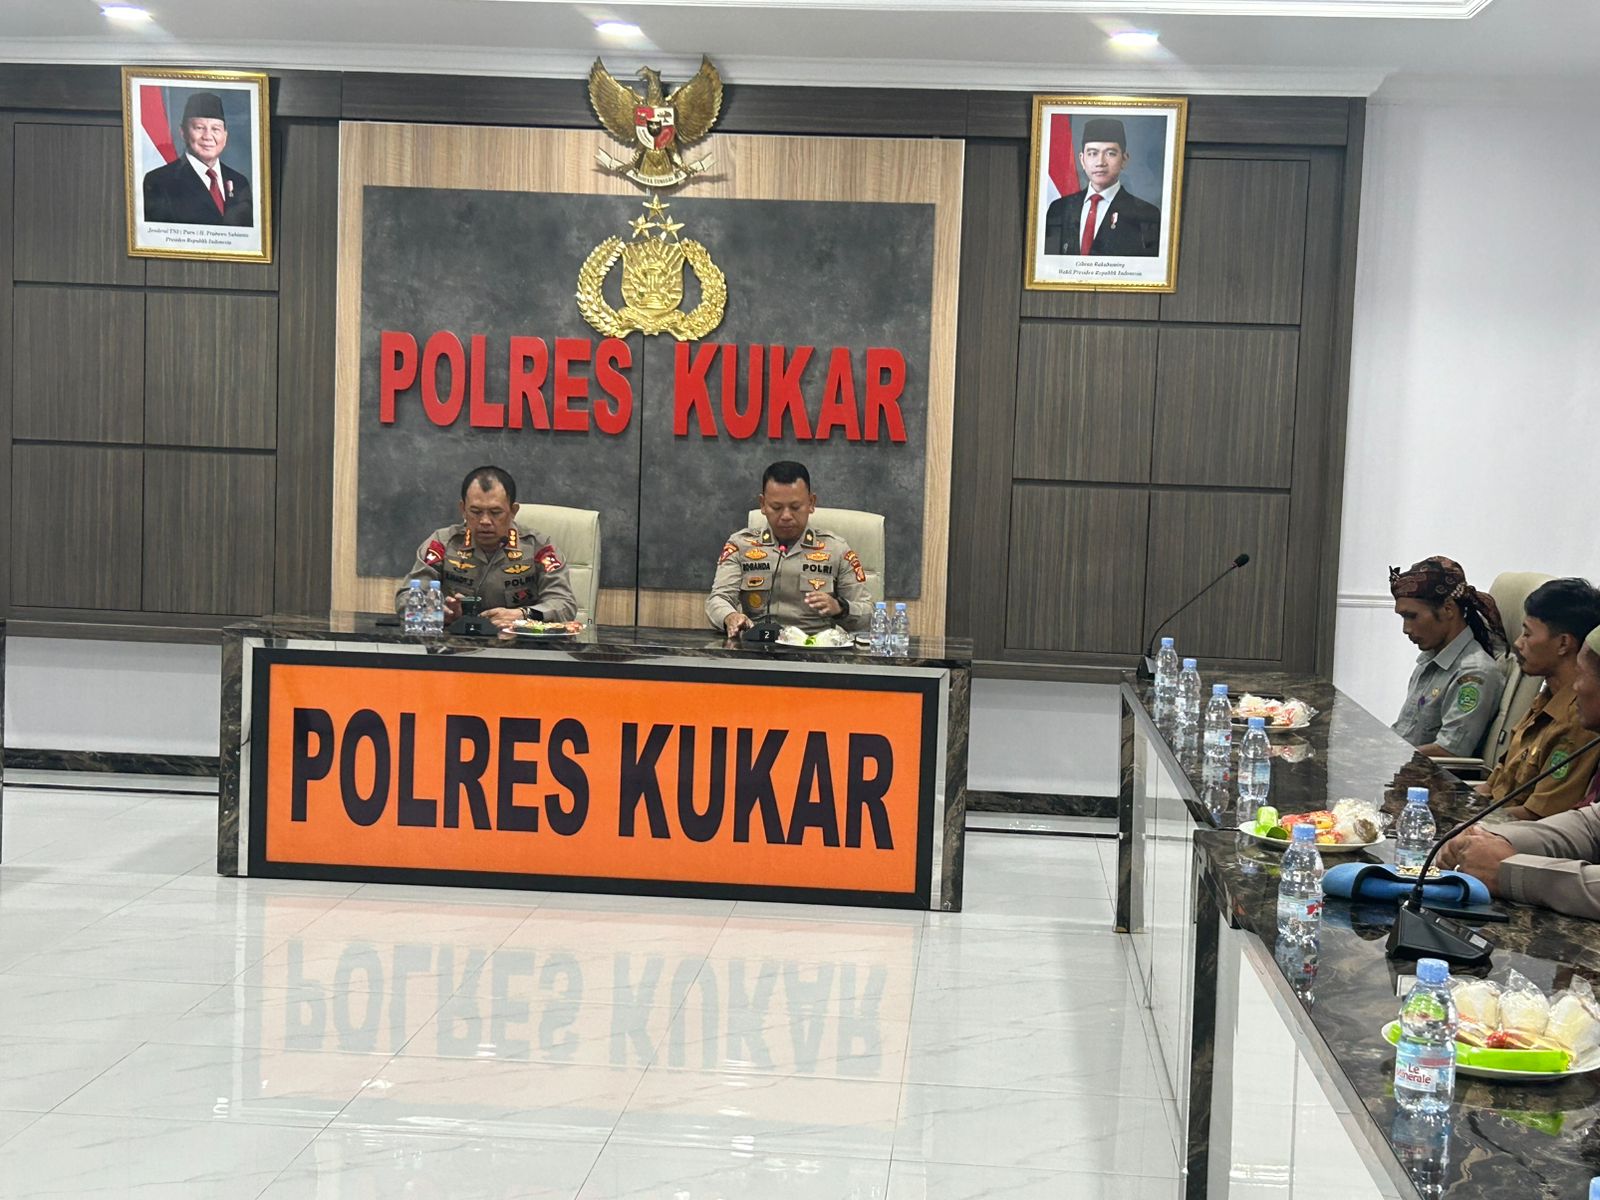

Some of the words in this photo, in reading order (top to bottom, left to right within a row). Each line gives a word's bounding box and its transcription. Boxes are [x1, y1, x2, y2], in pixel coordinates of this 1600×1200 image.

[379, 330, 633, 436] POLRES
[673, 341, 909, 443] KUKAR
[803, 563, 833, 574] POLRI
[764, 631, 770, 639] 2
[291, 707, 590, 836] POLRES
[618, 722, 895, 850] KUKAR
[1408, 1063, 1420, 1074] Le
